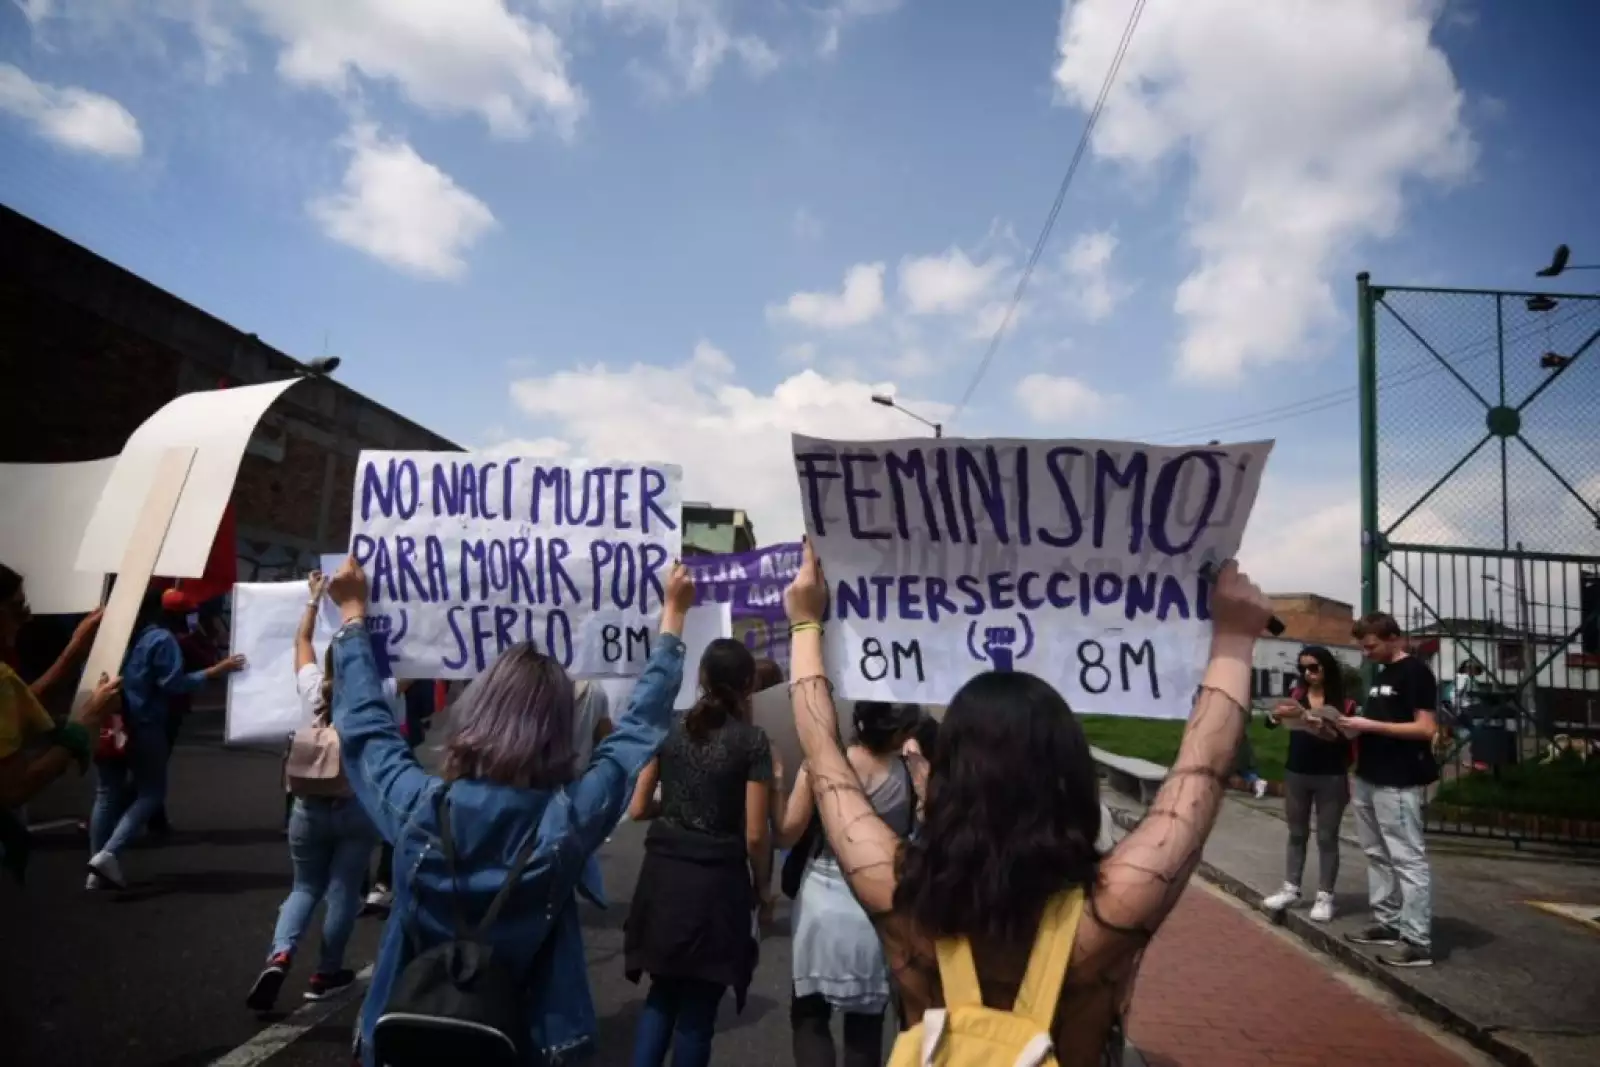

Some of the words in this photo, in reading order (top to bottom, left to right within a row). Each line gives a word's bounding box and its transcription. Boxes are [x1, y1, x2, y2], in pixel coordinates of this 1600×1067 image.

[361, 457, 419, 521] NO
[432, 456, 521, 521] NACÍ
[530, 466, 676, 533] MUJER
[796, 446, 1228, 556] FEMINISMO
[352, 534, 449, 604] PARA
[460, 537, 581, 606] MORIR
[590, 540, 665, 614] POR
[822, 570, 1212, 622] NTERSECCIONAL
[602, 624, 650, 662] 8M
[860, 637, 925, 681] 8M
[1077, 638, 1161, 699] 8M
